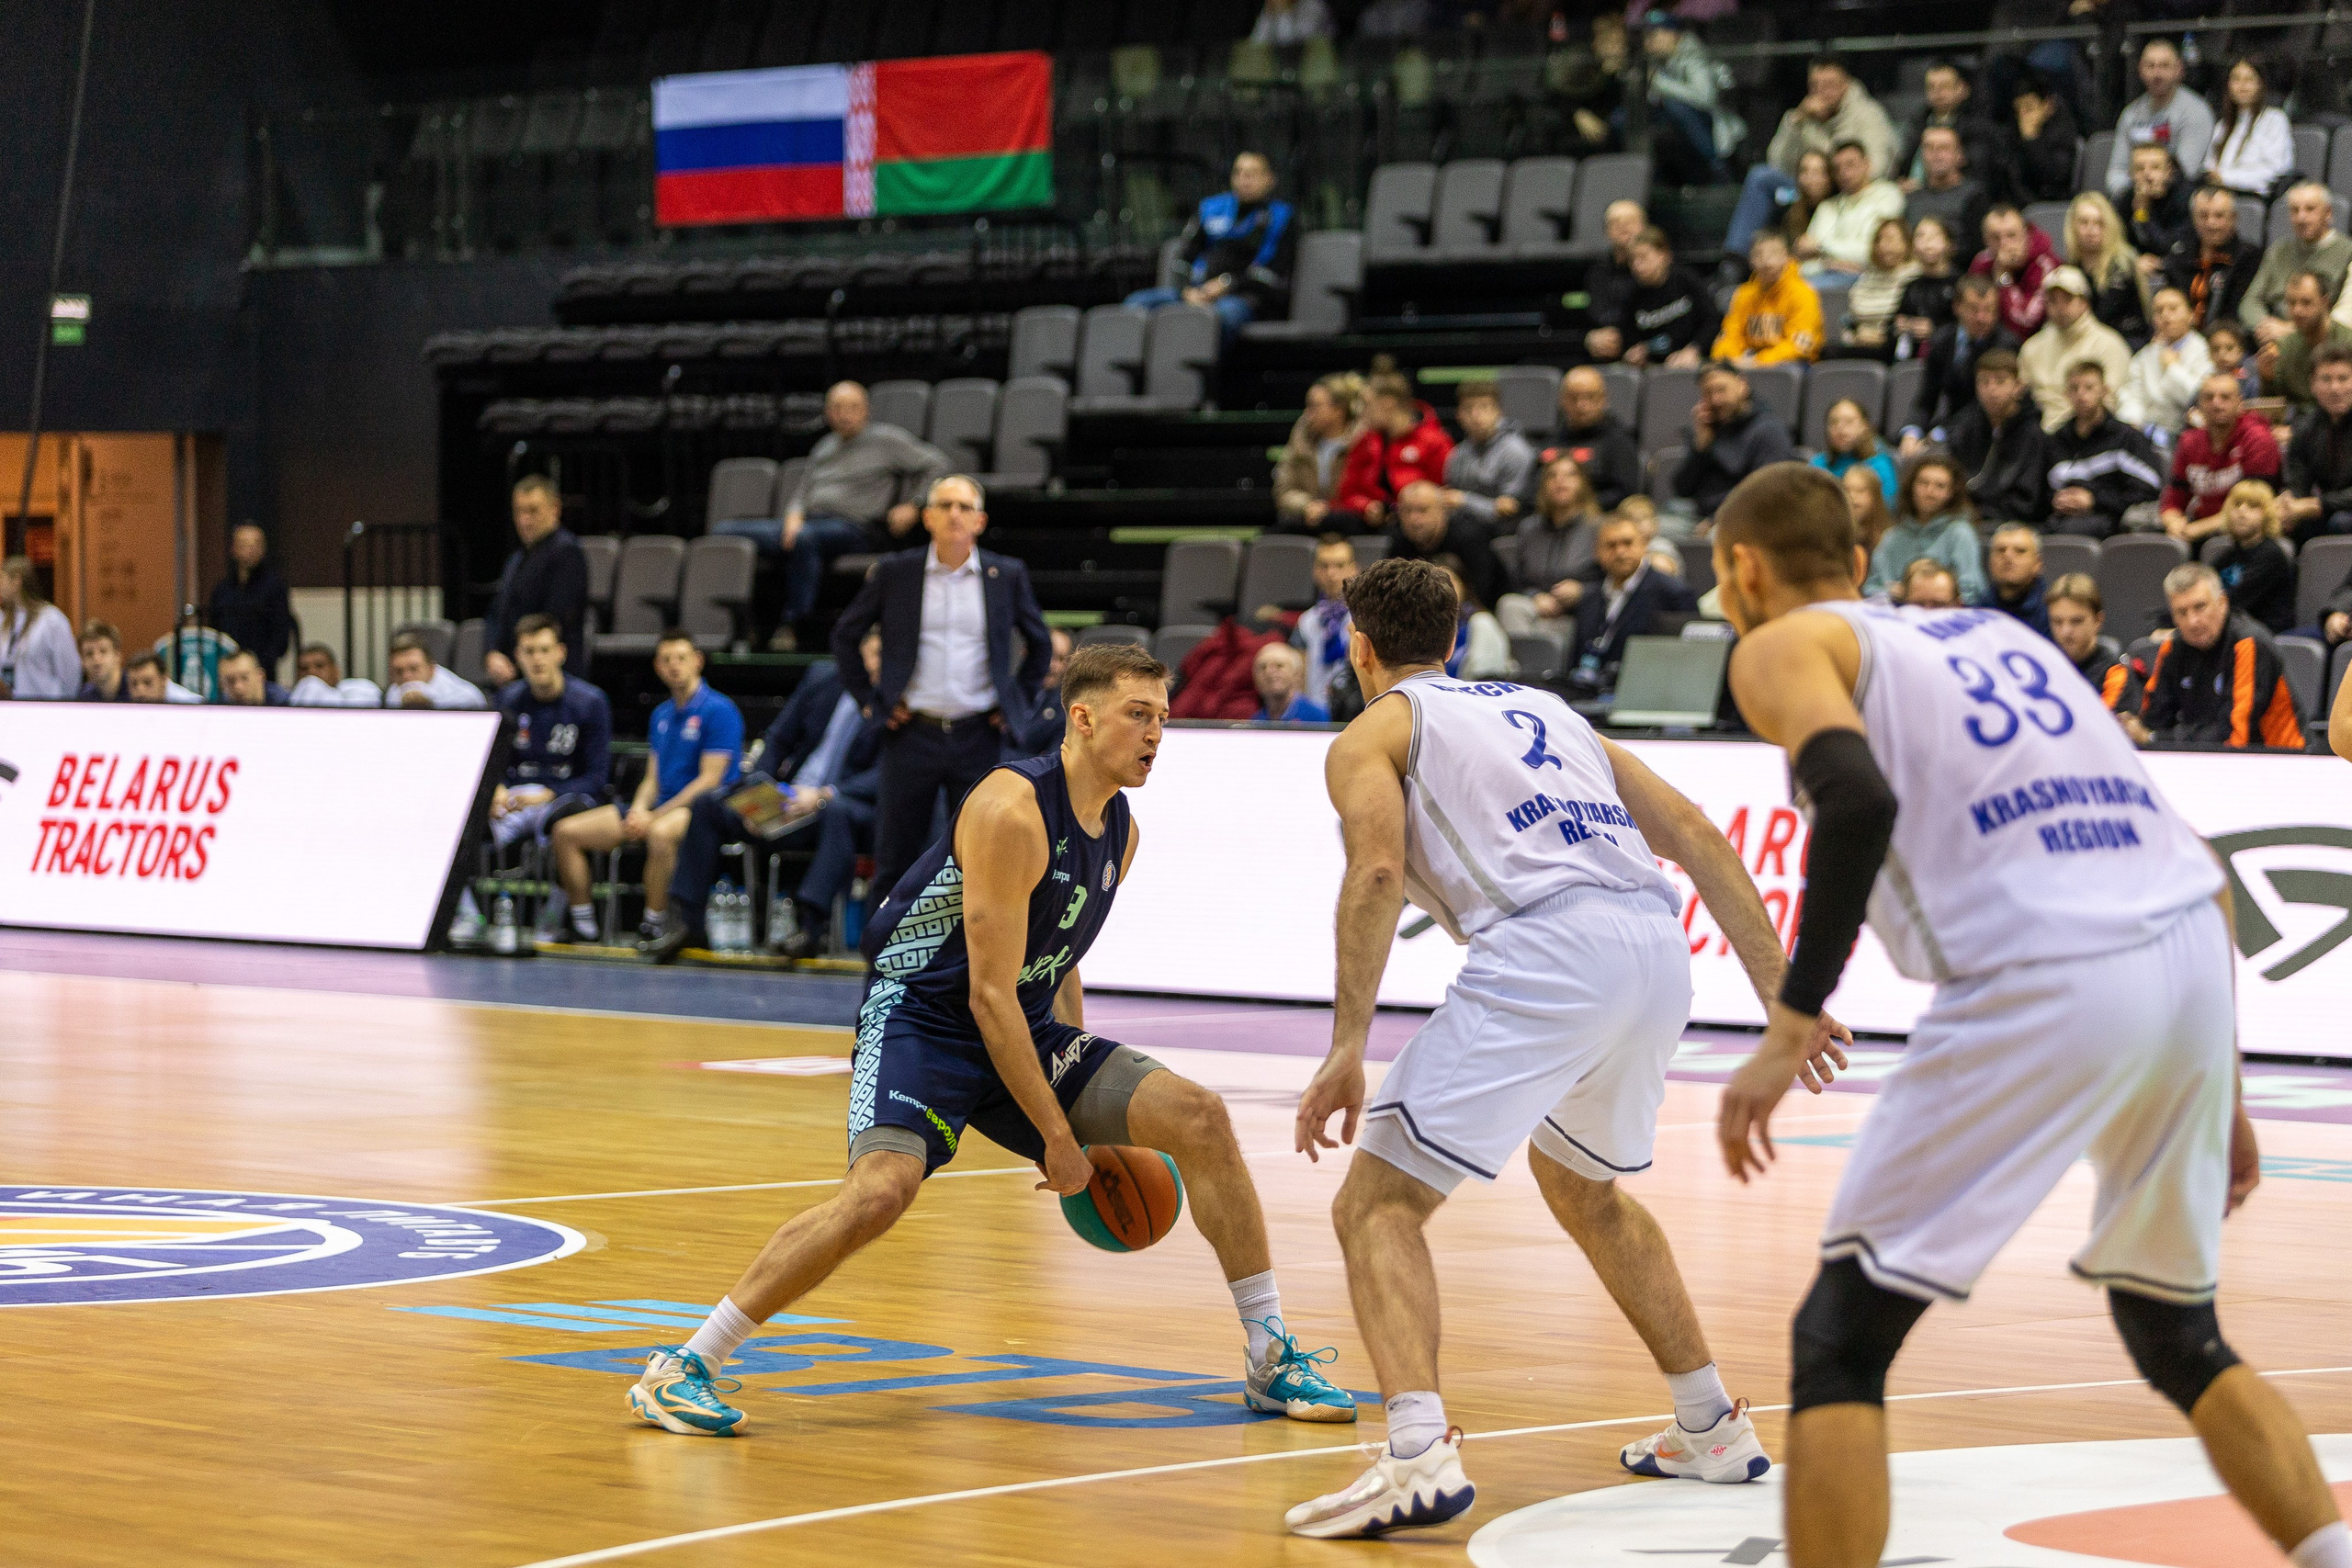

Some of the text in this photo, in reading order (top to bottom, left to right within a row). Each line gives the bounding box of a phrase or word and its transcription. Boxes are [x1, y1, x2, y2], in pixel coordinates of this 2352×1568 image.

[1947, 649, 2075, 748] 33
[1501, 709, 1563, 771] 2
[47, 754, 239, 814] BELARUS
[31, 820, 216, 880] TRACTORS
[1057, 885, 1088, 930] 3
